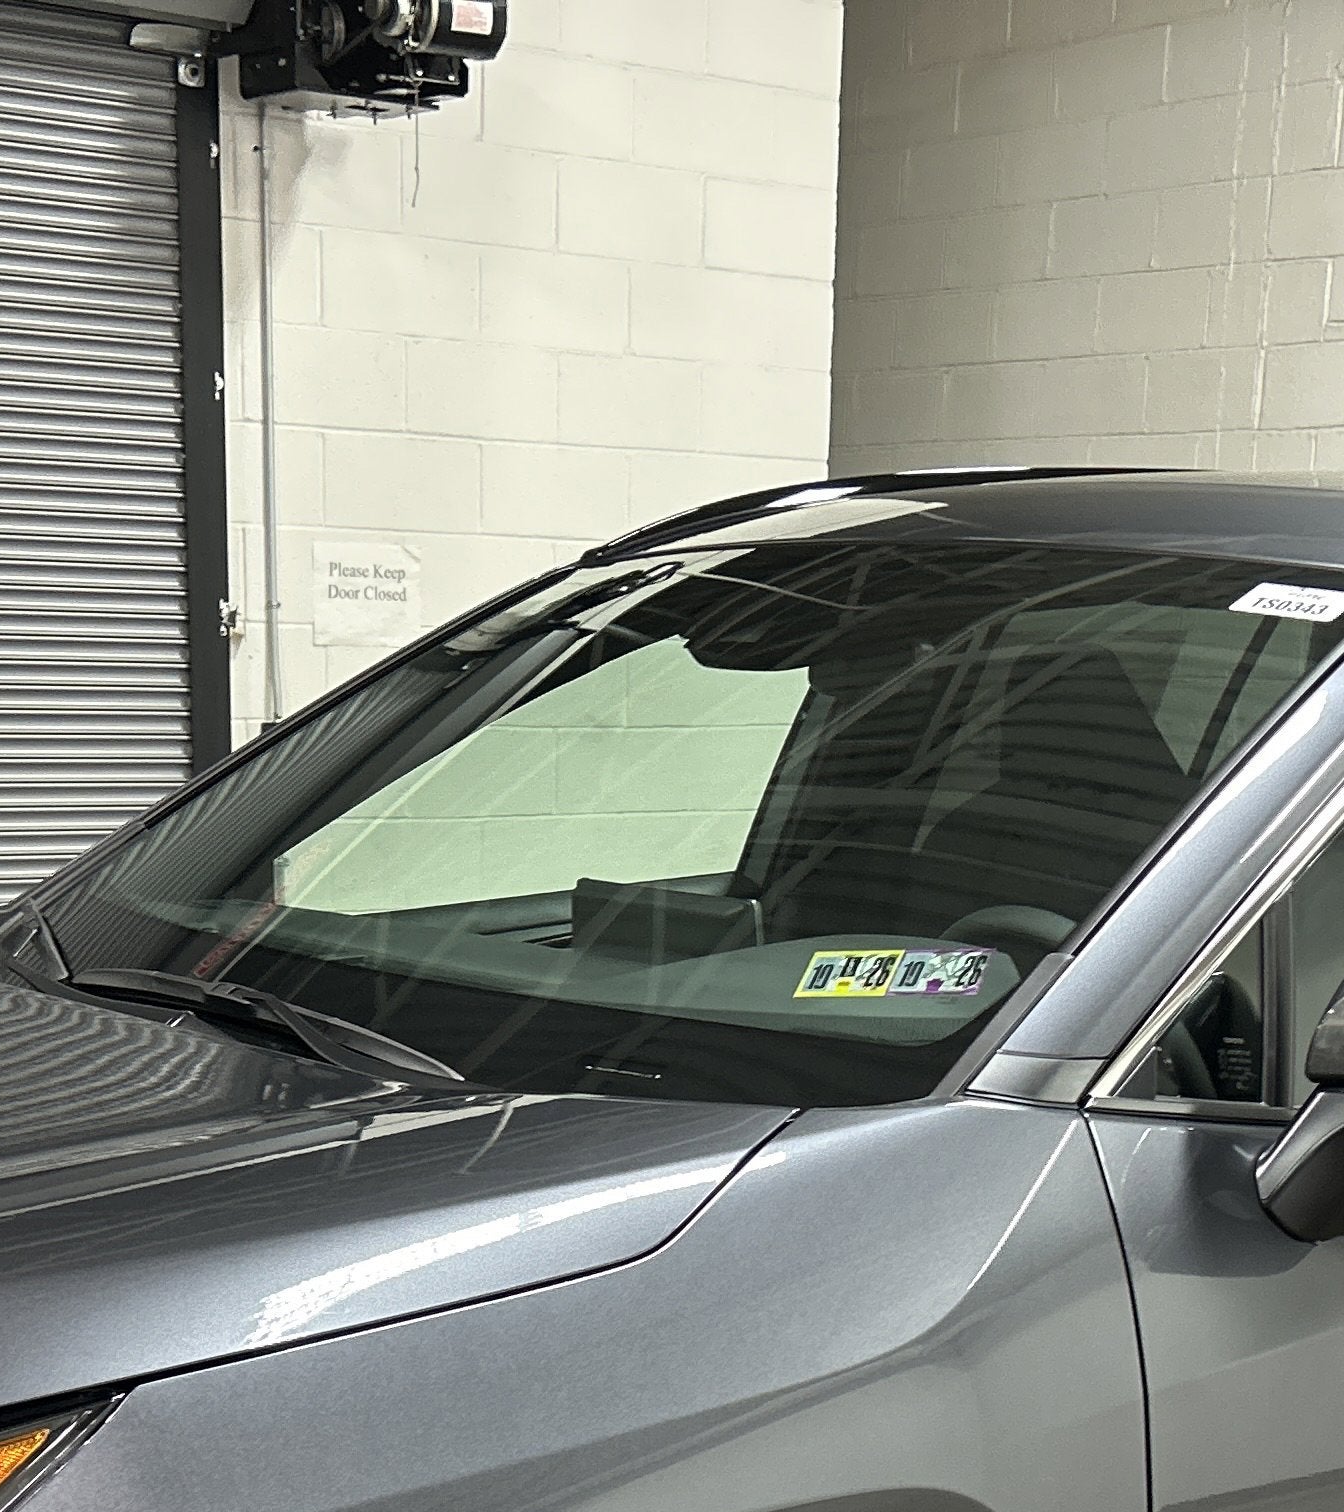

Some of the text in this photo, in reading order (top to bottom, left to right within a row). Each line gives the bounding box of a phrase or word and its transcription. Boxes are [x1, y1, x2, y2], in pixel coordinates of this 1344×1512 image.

[329, 562, 406, 583] Please Keep
[328, 585, 407, 601] Door Closed
[808, 963, 834, 989] 10
[899, 955, 989, 987] 10 26
